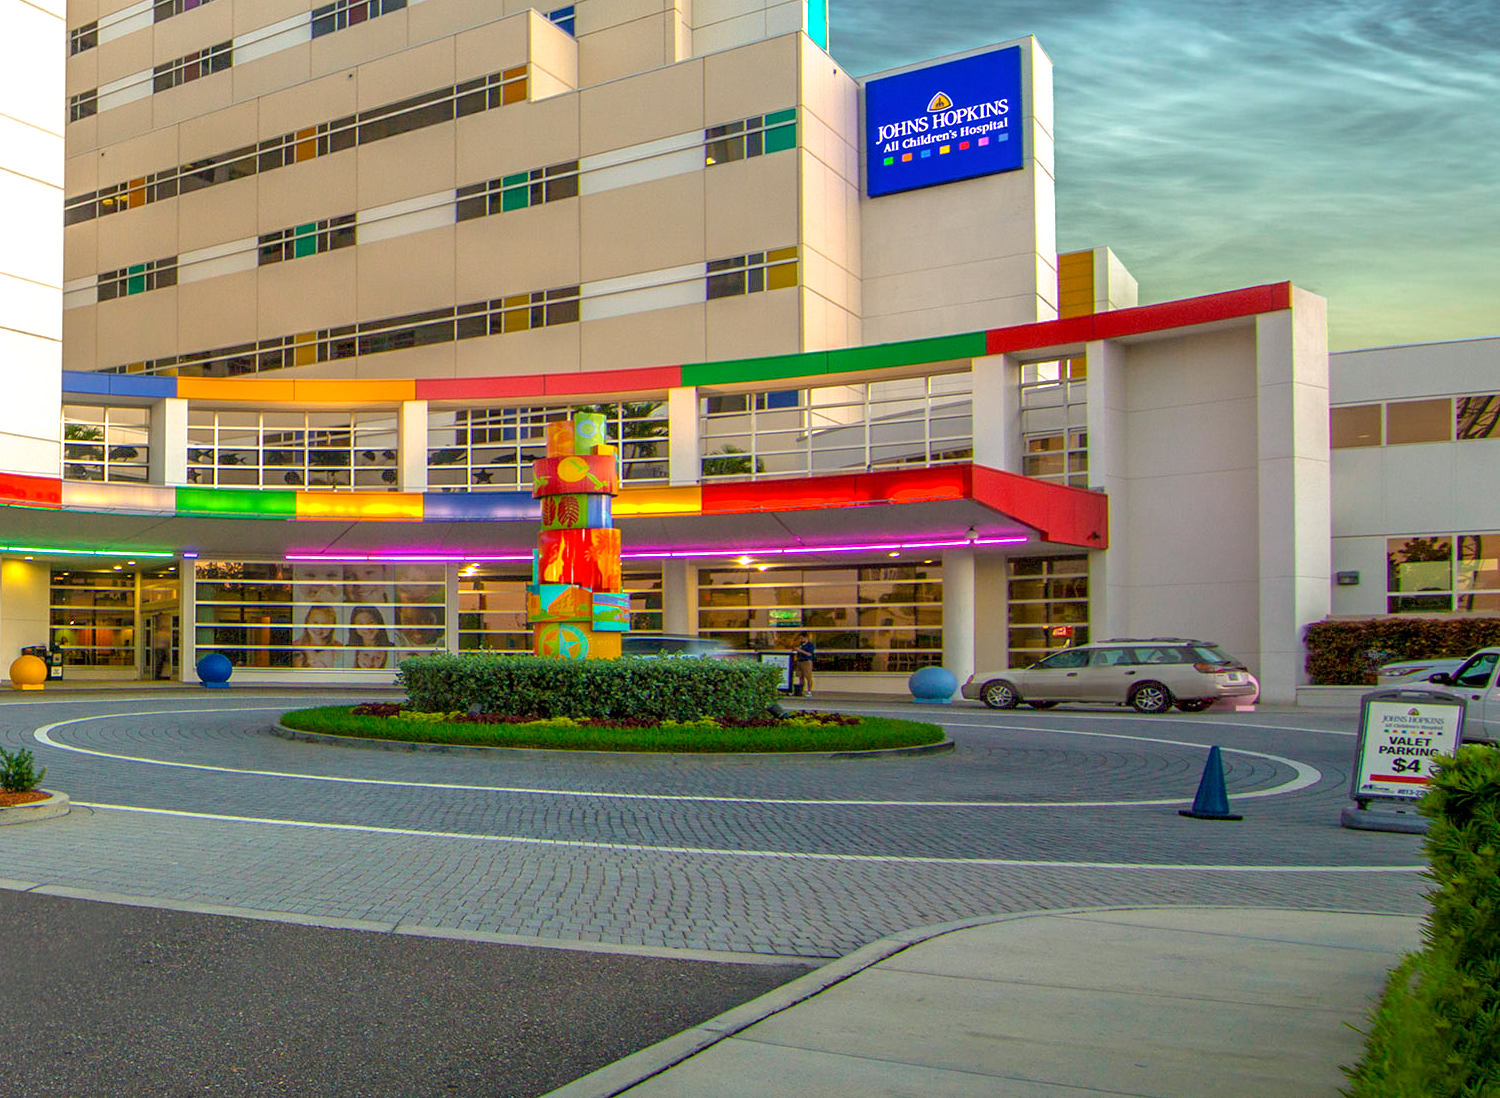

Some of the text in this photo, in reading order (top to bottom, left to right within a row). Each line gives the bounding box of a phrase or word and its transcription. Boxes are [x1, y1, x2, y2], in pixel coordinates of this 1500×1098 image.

[875, 98, 1009, 145] JOHNS HOPKINS
[883, 117, 1008, 153] All Children's Hospital
[1381, 715, 1444, 725] JOHNS HOPKINS
[1389, 736, 1432, 746] VALET
[1392, 757, 1421, 773] $4
